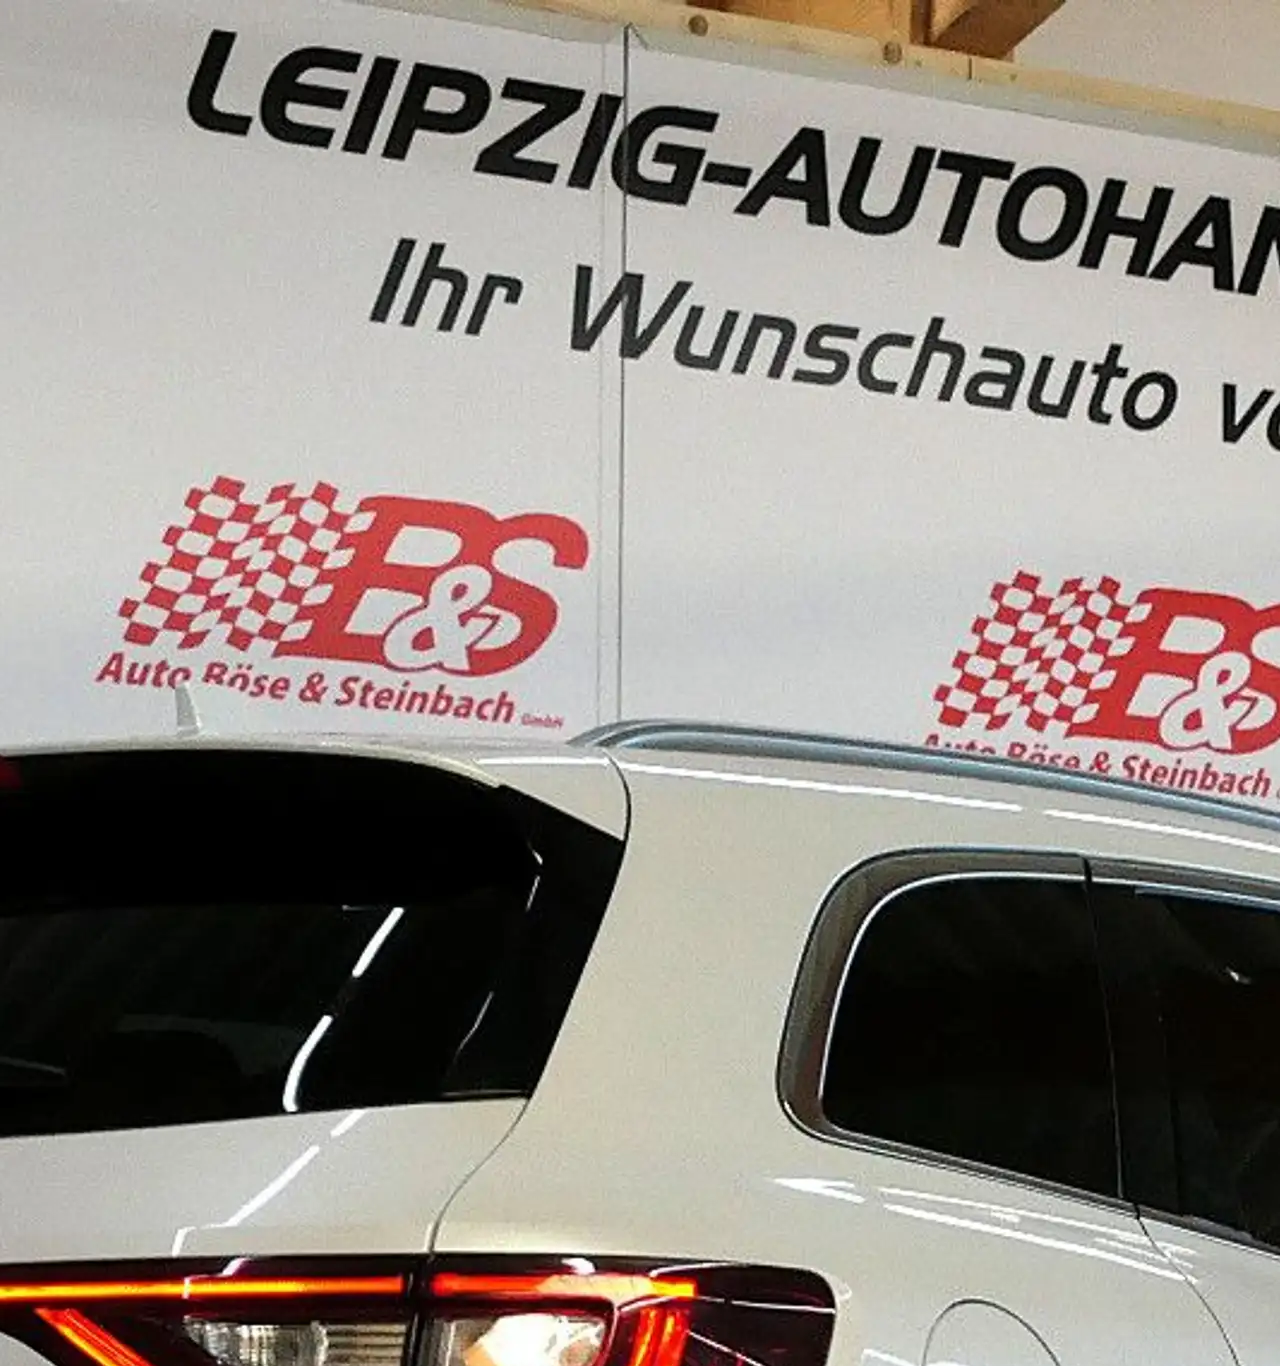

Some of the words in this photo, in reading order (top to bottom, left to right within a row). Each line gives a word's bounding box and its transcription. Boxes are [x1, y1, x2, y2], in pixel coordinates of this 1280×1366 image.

[370, 238, 523, 336] Ihr
[570, 264, 1177, 432] Wunschauto
[96, 652, 192, 690] Auto
[202, 661, 291, 700] Böse
[299, 672, 327, 703] &
[334, 674, 515, 724] Steinbach
[1122, 752, 1271, 797] Steinbach
